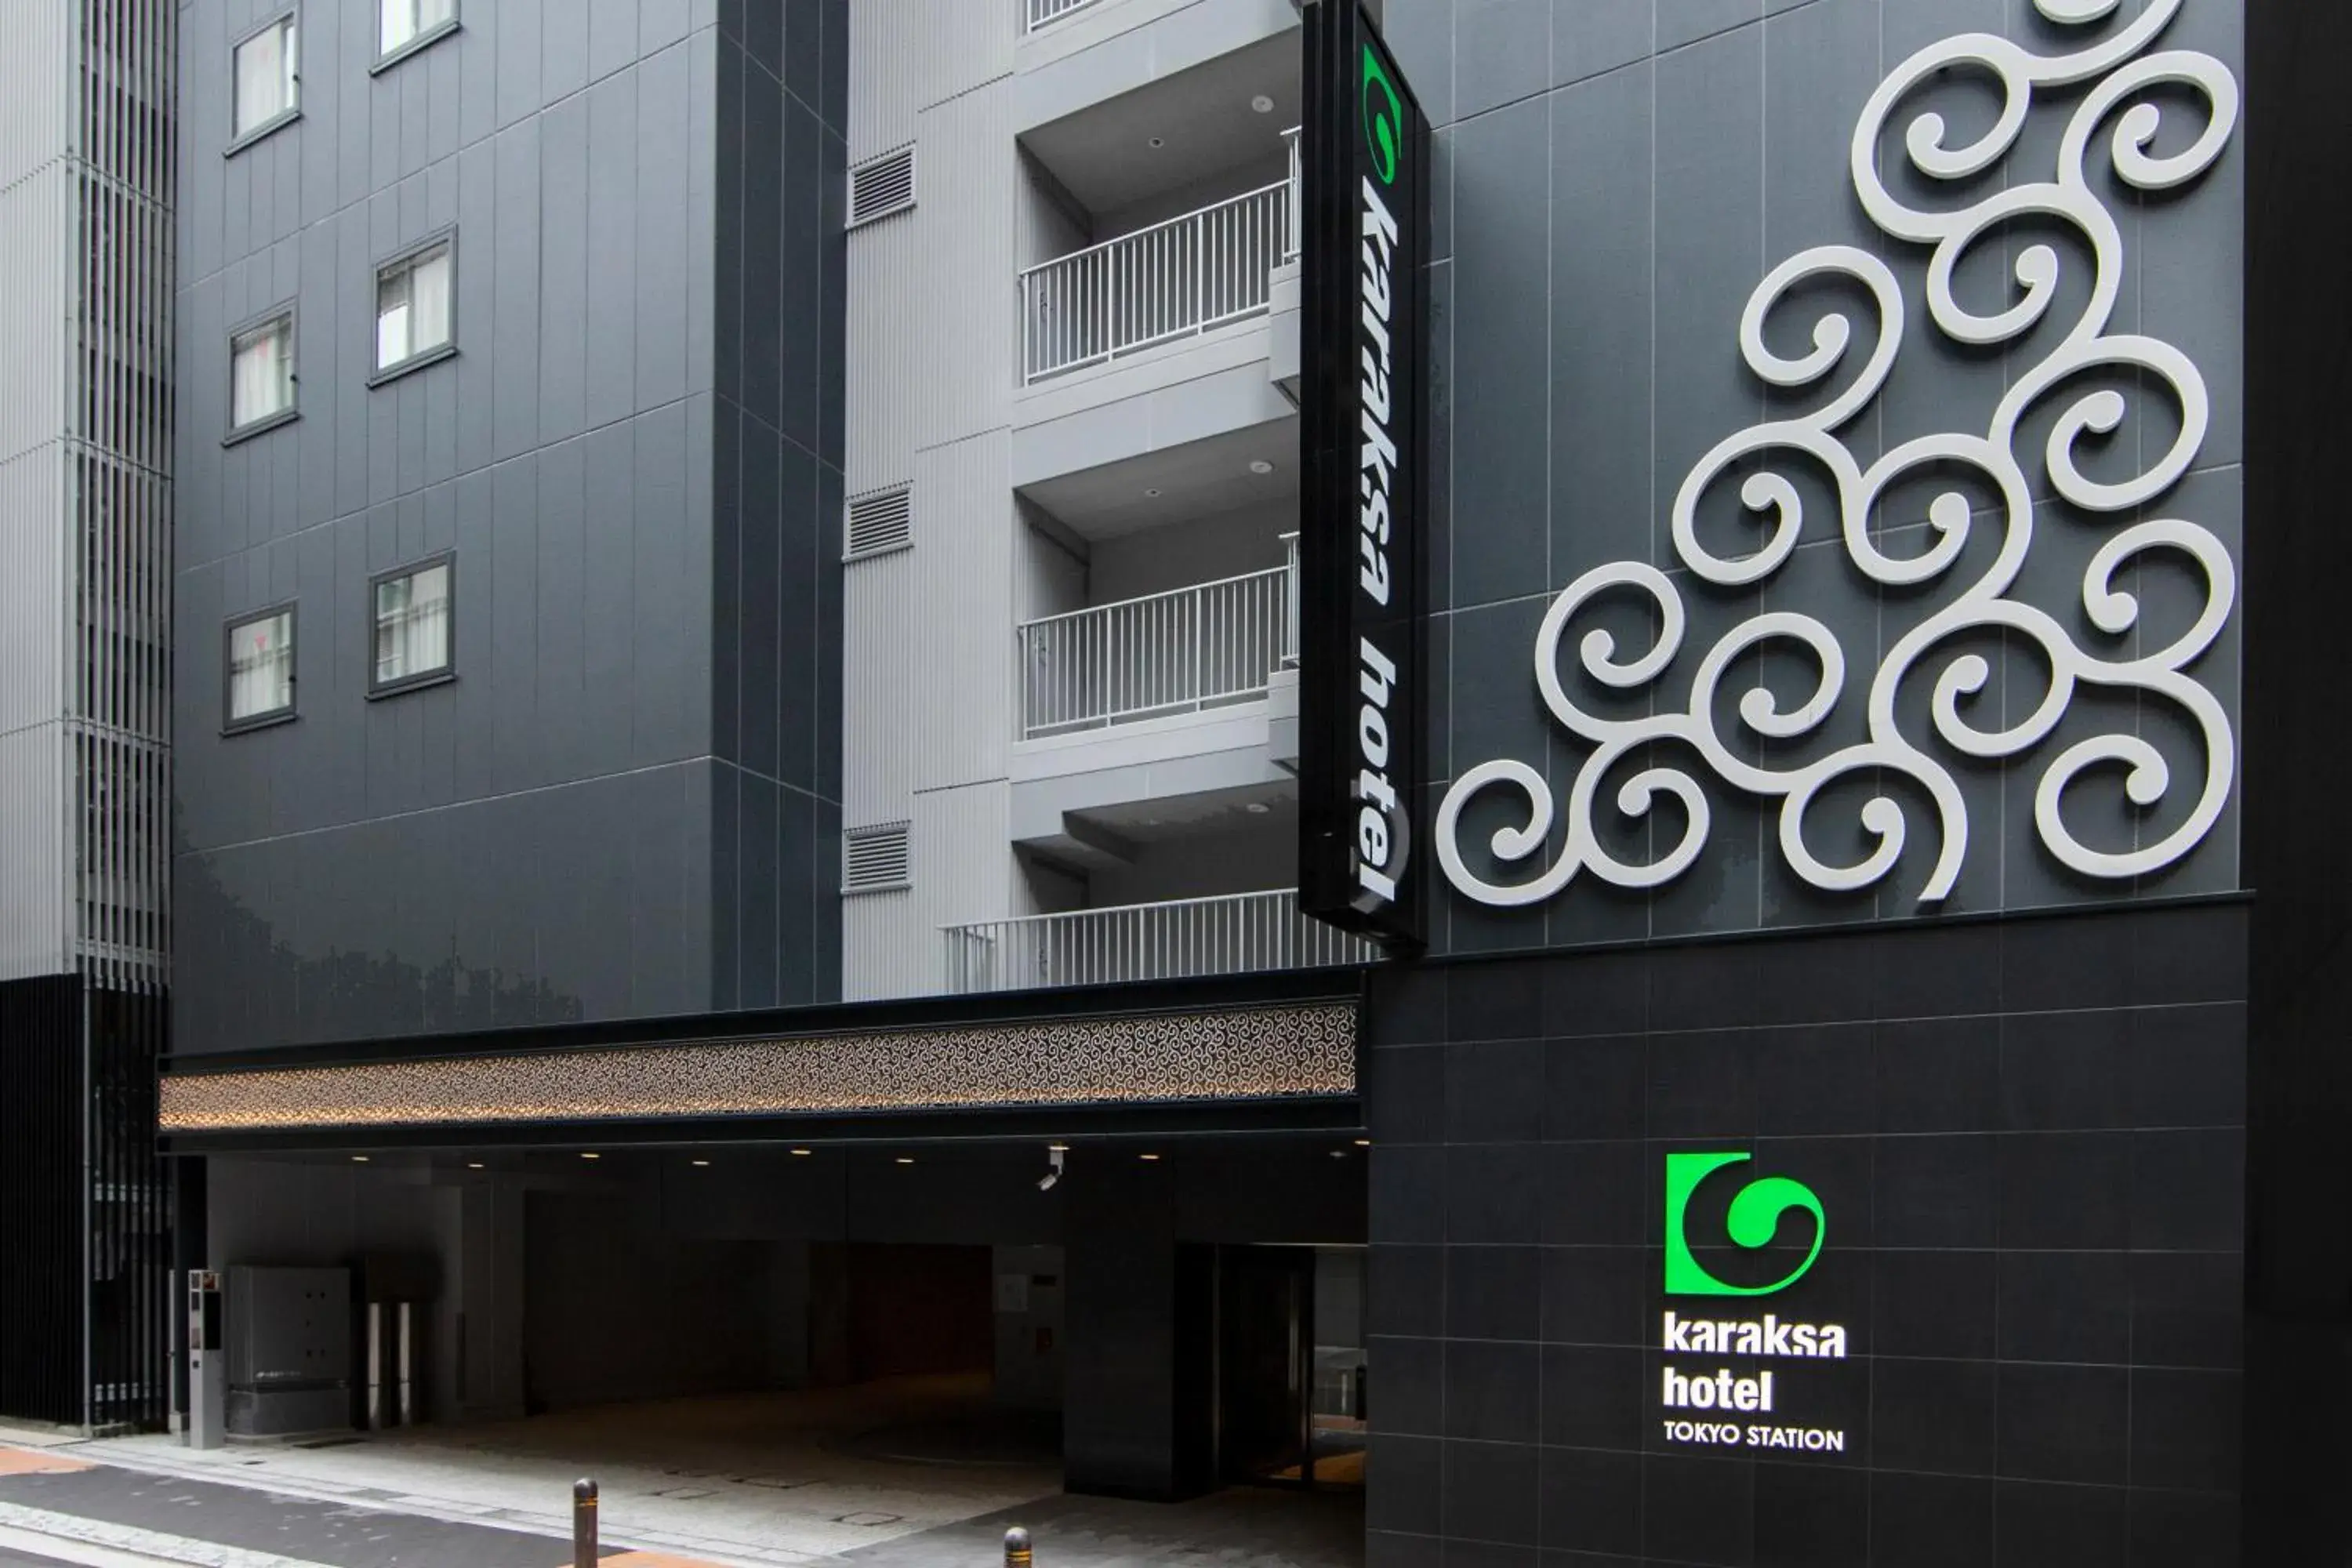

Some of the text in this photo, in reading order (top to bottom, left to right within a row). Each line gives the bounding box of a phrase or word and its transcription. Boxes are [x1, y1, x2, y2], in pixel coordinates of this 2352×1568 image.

[1359, 175, 1398, 902] karaksa hotel
[1663, 1311, 1846, 1359] karaksa
[1663, 1367, 1773, 1412] hotel
[1664, 1421, 1845, 1451] TOKYO STATION
